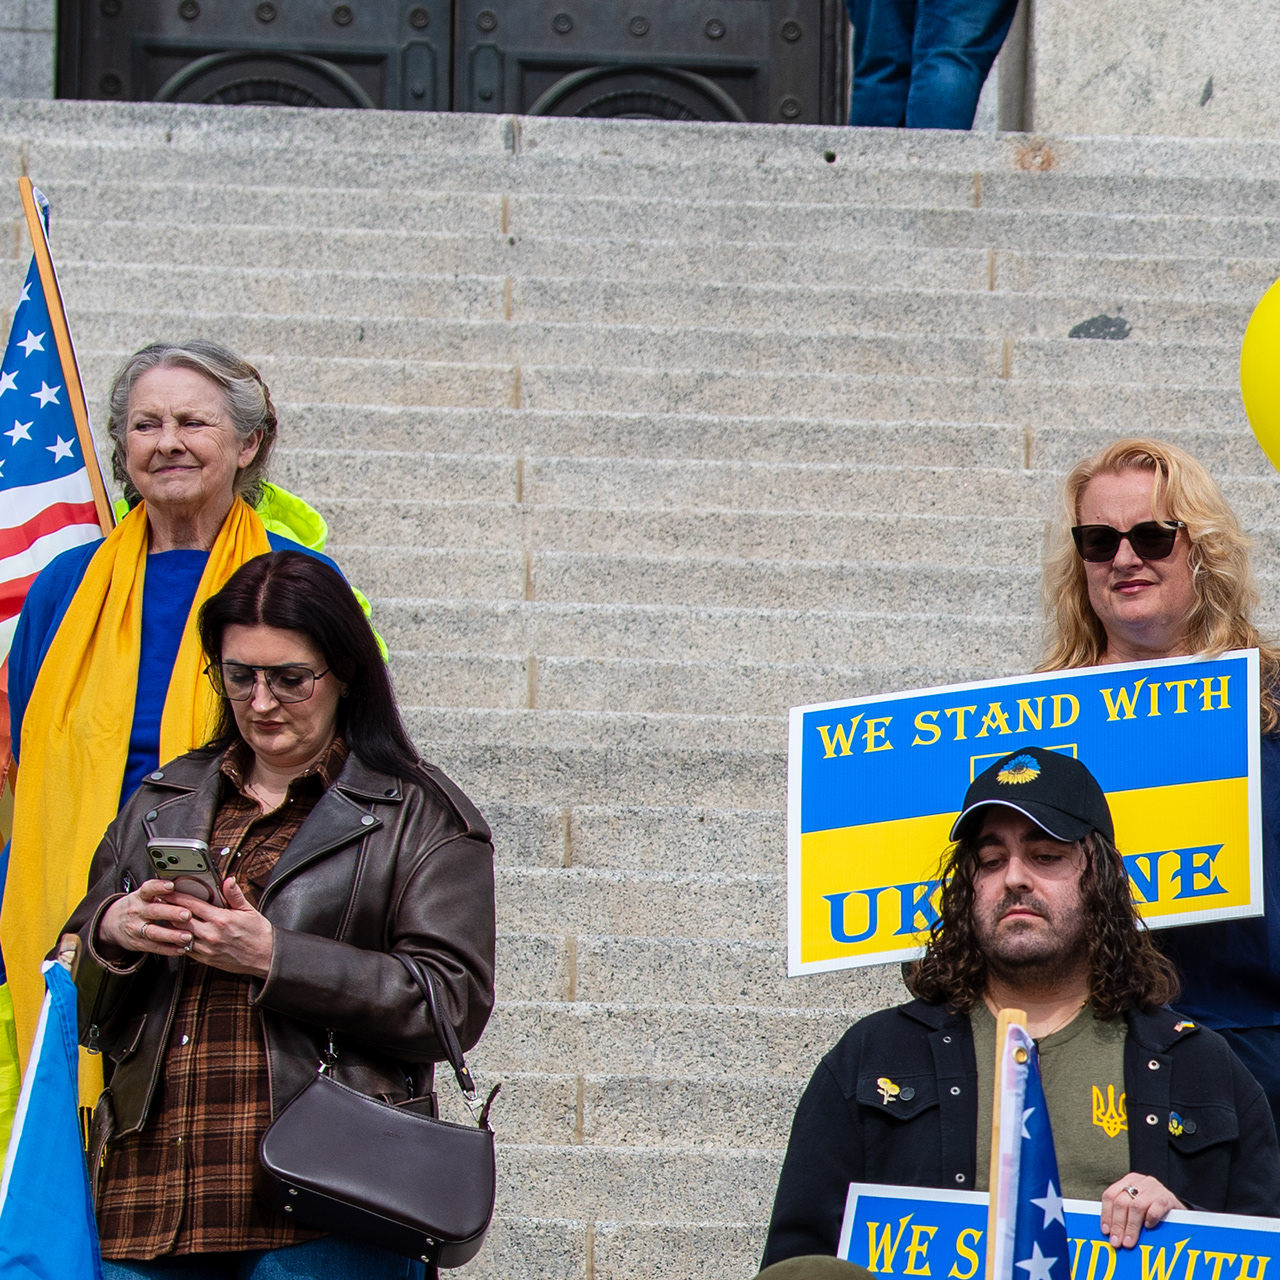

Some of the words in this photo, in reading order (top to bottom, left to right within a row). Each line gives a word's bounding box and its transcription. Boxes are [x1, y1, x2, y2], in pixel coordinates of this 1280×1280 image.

[816, 711, 895, 760] WE
[911, 693, 1081, 748] STAND
[1099, 674, 1232, 724] WITH
[821, 843, 1229, 946] UKNE
[866, 1209, 939, 1277] WE
